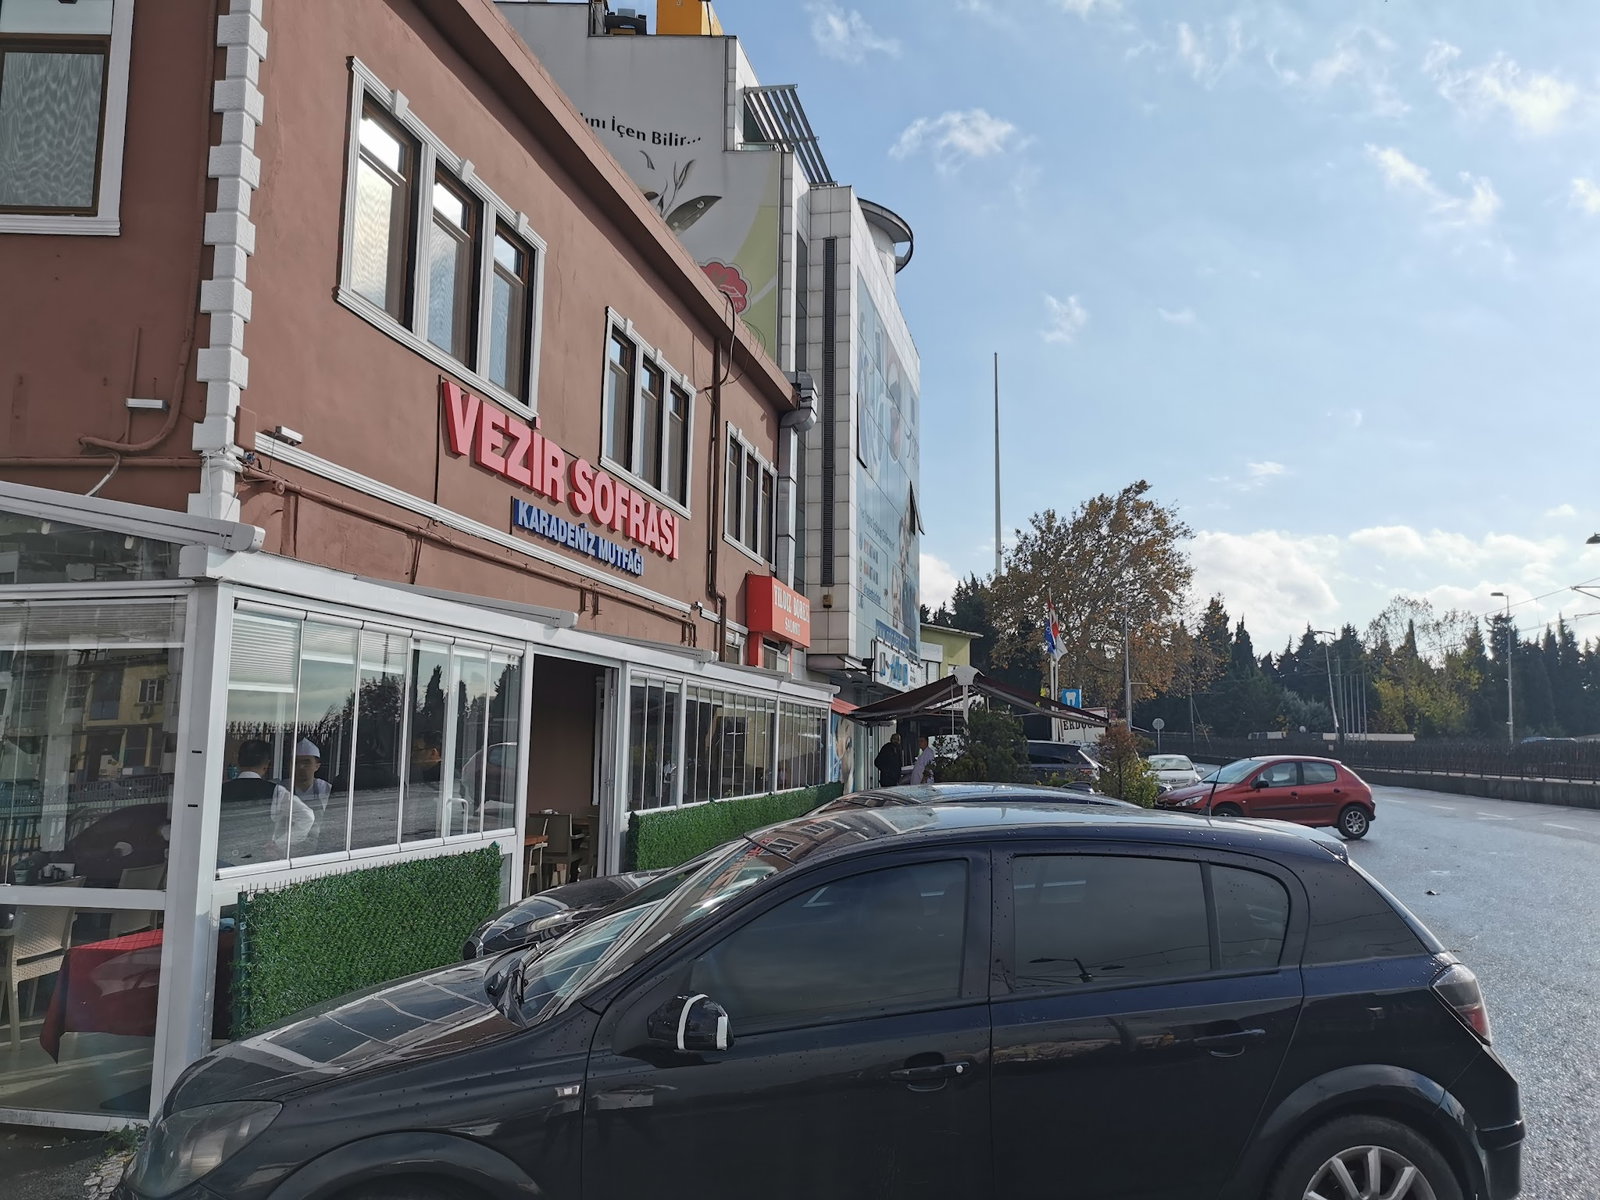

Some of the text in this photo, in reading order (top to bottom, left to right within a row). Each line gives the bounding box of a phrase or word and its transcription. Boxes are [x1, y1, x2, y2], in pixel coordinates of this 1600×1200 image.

[611, 115, 646, 142] İçen
[442, 380, 679, 560] VEZİR SOFRASI
[514, 499, 645, 577] KARADENİZ MUTFAĞI
